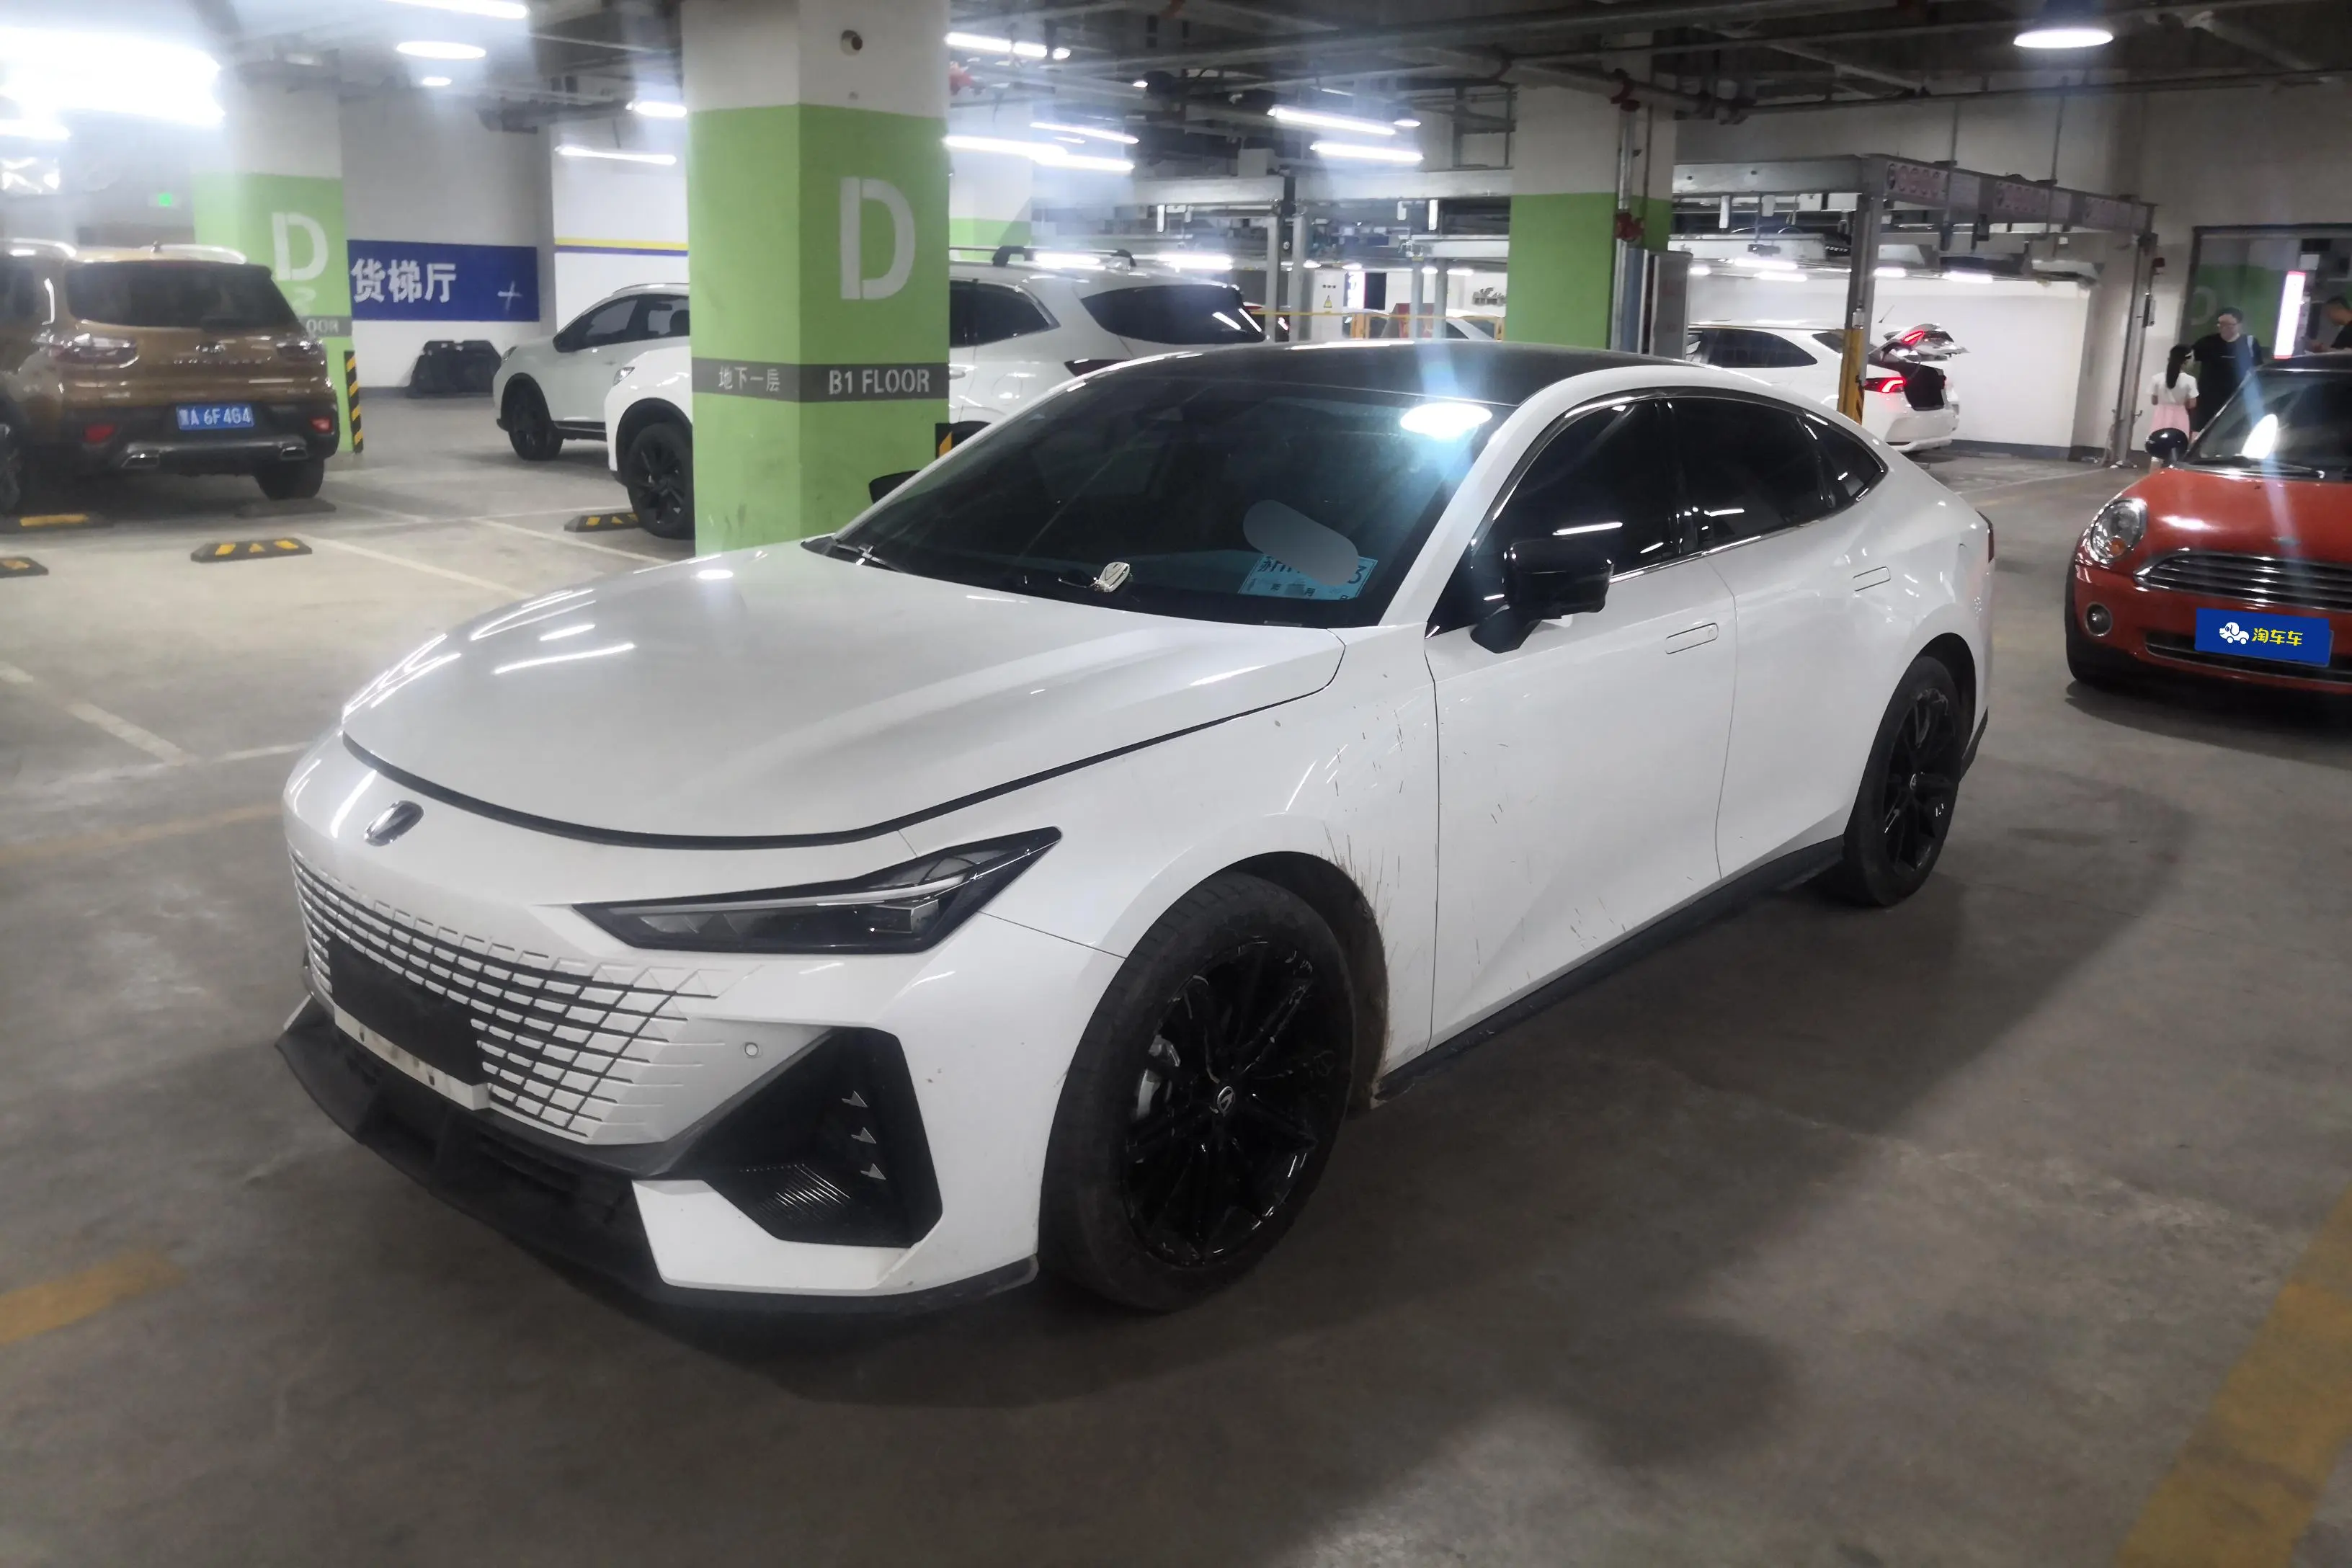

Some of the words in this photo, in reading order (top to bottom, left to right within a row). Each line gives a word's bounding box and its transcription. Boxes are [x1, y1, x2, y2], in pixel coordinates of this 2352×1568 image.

[272, 211, 329, 281] D
[840, 177, 915, 300] D
[350, 257, 458, 303] 货梯厅
[718, 365, 781, 392] 地下一层
[829, 369, 853, 395] B1
[861, 368, 930, 393] FLOOR
